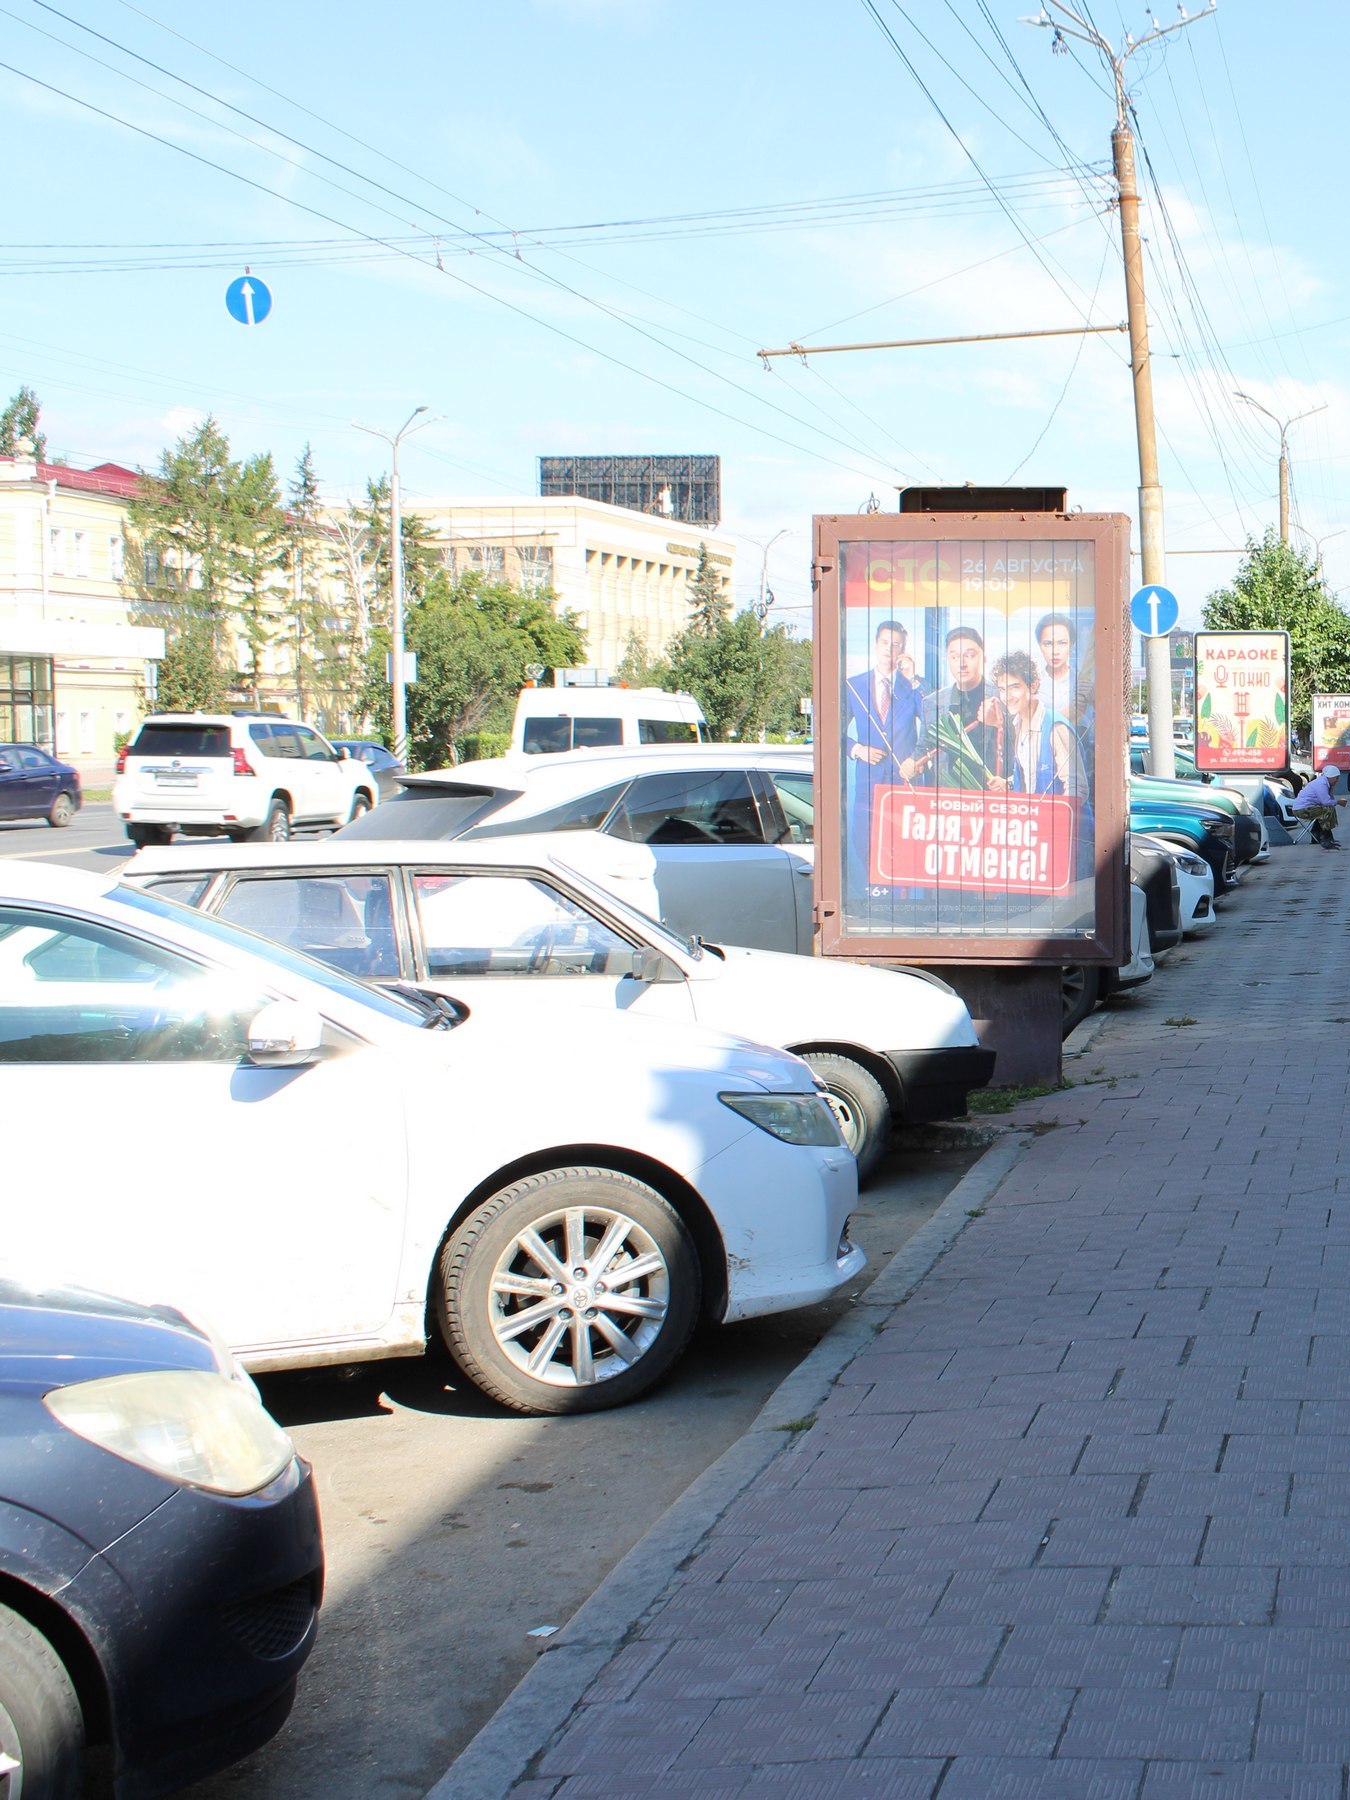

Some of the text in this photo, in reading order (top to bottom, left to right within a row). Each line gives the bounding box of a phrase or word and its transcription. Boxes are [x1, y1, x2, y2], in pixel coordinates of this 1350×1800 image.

[963, 558, 1084, 573] 26 АВГУСТА
[864, 559, 952, 592] СТС
[963, 577, 1015, 592] 19:00
[1206, 649, 1278, 660] КАРАОКЕ
[1232, 671, 1270, 687] ТОКИО
[930, 799, 1039, 816] НОВЫЙ СЕЗОН
[902, 805, 1038, 846] Галя, у нас
[925, 842, 1048, 882] отмена!
[865, 886, 889, 897] 16+
